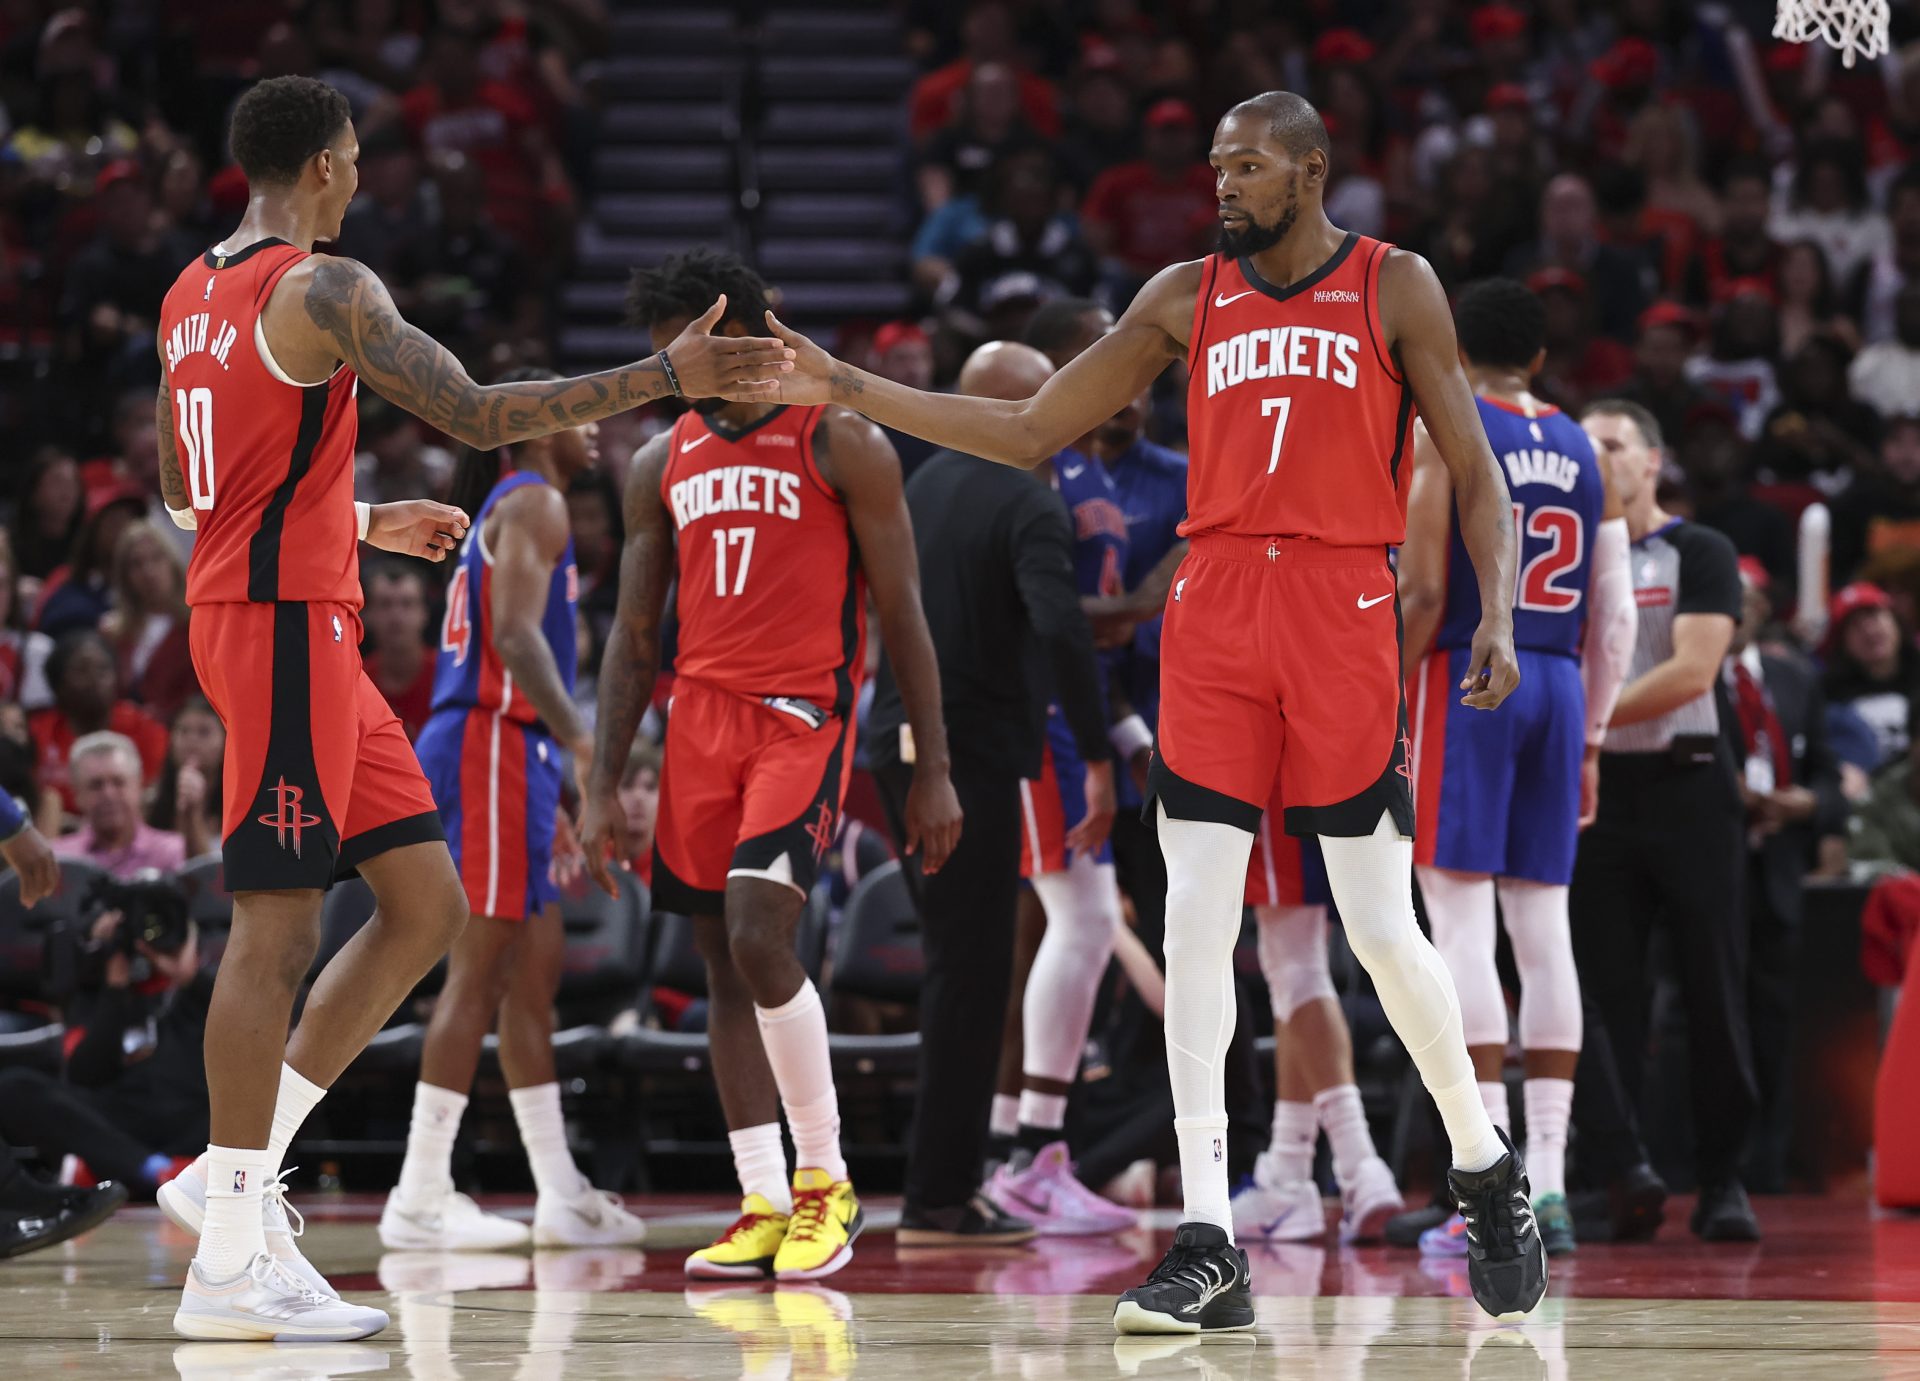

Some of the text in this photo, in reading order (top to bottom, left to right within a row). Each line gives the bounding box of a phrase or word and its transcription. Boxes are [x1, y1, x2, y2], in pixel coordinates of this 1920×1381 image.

[1313, 290, 1359, 298] MEMORIAL
[1313, 295, 1359, 303] HERMANN
[165, 312, 237, 373] SMITH JR.
[1207, 326, 1360, 399] ROCKETS
[176, 387, 215, 510] 10
[1261, 396, 1292, 475] 7
[670, 465, 800, 531] ROCKETS
[1504, 449, 1580, 493] HARRIS
[712, 526, 756, 598] 17
